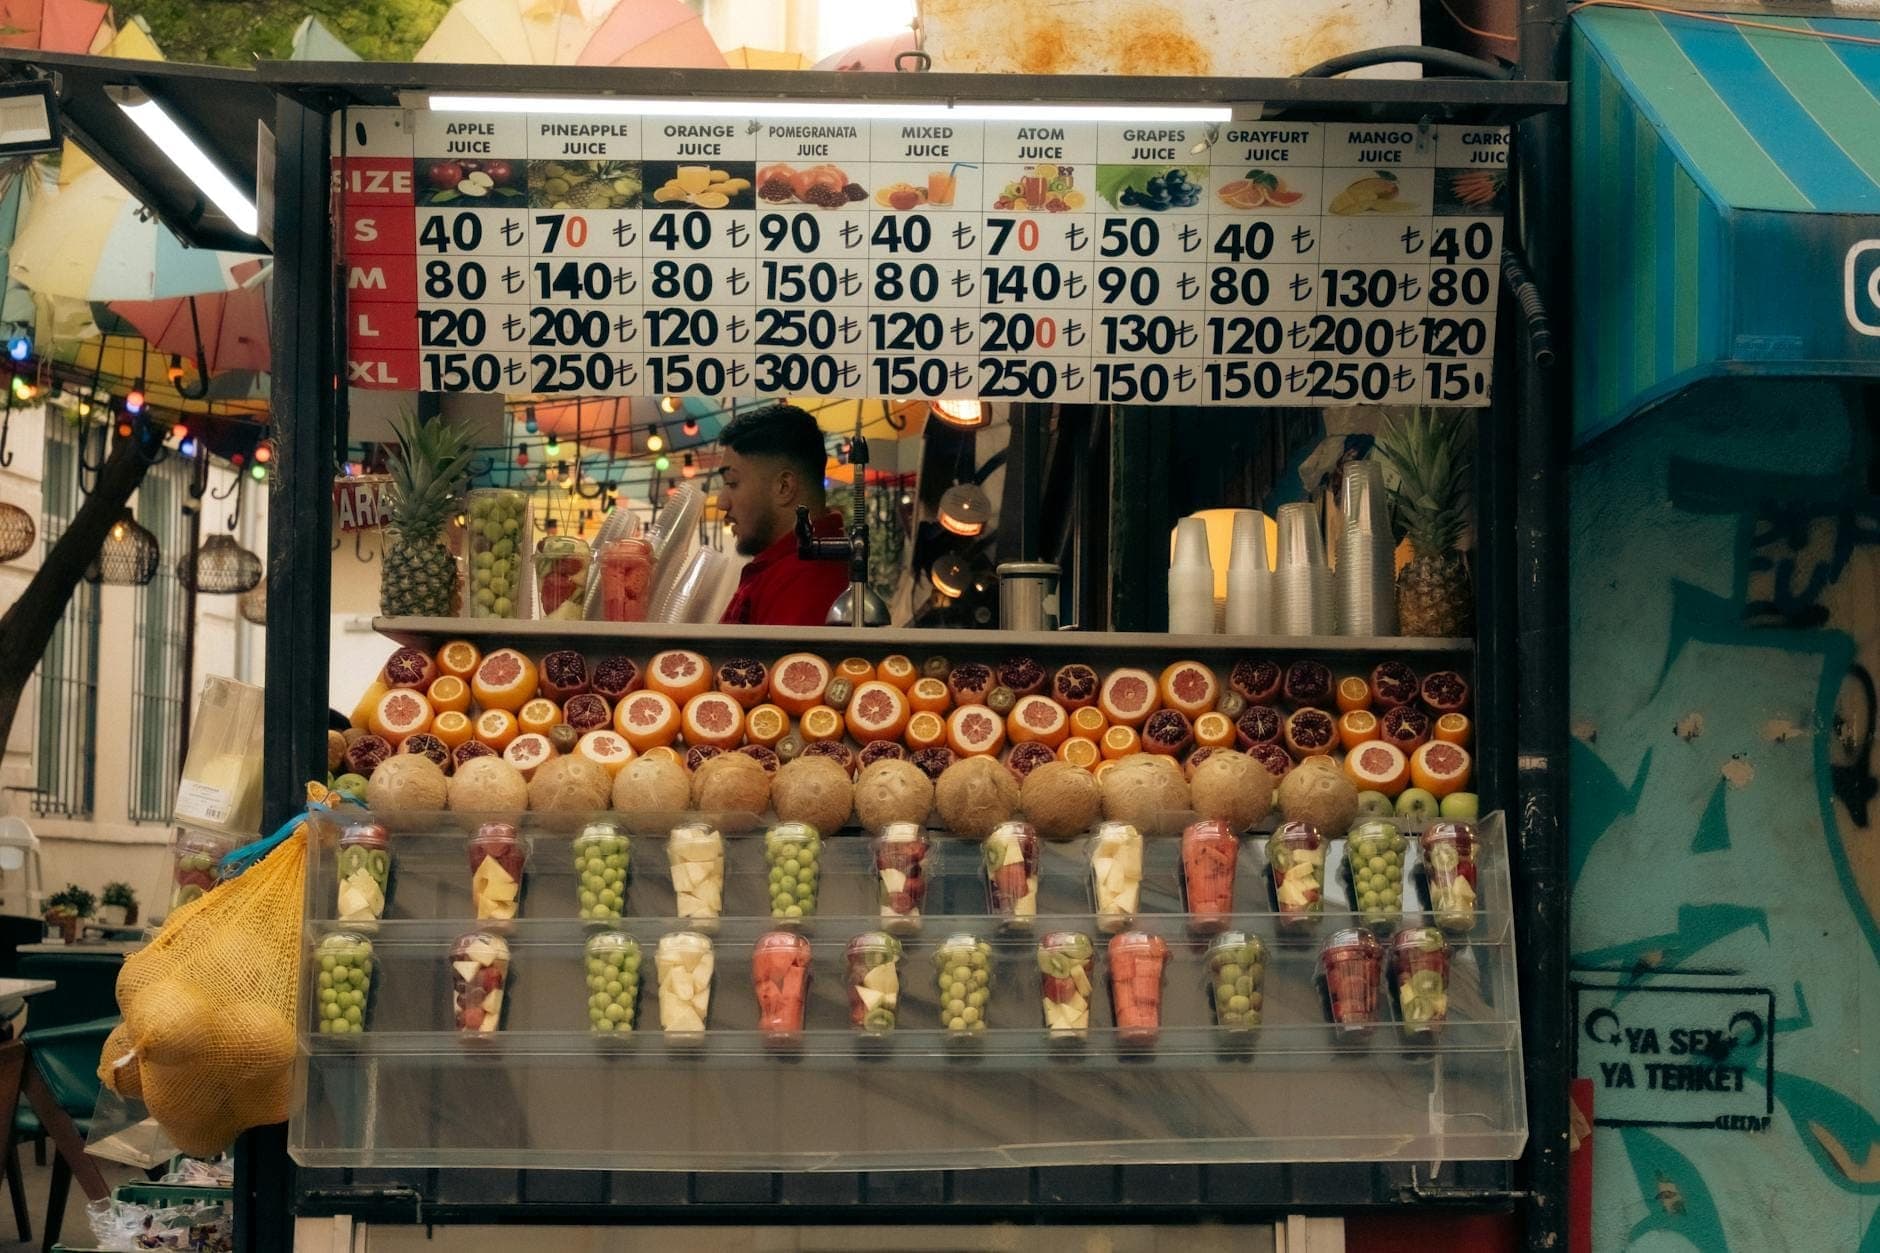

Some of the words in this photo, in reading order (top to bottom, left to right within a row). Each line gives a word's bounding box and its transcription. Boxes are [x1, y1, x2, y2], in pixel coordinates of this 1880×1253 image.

[446, 123, 495, 135] APPLE
[447, 141, 490, 153] JUICE
[541, 124, 627, 136] PINEAPPLE
[562, 142, 606, 154] JUICE
[664, 125, 734, 137] ORANGE
[769, 126, 857, 138] POMEGRANATA
[902, 127, 953, 139] MIXED
[1017, 128, 1064, 140] ATOM
[1123, 130, 1185, 142] GRAPES
[1227, 131, 1309, 143] GRAYFURT
[1348, 132, 1413, 144] MANGO
[677, 144, 721, 155] JUICE
[797, 145, 828, 156] JUICE
[905, 145, 949, 157] JUICE
[1018, 147, 1062, 159] JUICE
[1131, 148, 1175, 160] JUICE
[1245, 149, 1289, 161] JUICE
[1358, 150, 1402, 162] JUICE
[1470, 151, 1509, 163] JUIC
[354, 219, 378, 242] S
[420, 212, 482, 253] 40
[535, 214, 587, 253] 70
[649, 211, 711, 251] 40
[759, 212, 820, 253] 90
[871, 214, 931, 253] 40
[986, 218, 1039, 255] 70
[1100, 218, 1159, 257] 50
[1214, 221, 1274, 262] 40
[1430, 222, 1493, 265] 40
[349, 268, 387, 289] M
[425, 261, 486, 300] 80
[534, 262, 612, 300] 140
[652, 260, 713, 301] 80
[762, 261, 837, 302] 150
[874, 262, 939, 302] 80
[982, 263, 1060, 304] 140
[1098, 266, 1159, 306] 90
[1210, 267, 1269, 306] 80
[1321, 269, 1397, 308] 130
[1428, 268, 1489, 306] 80
[359, 315, 379, 336] L
[416, 308, 486, 347] 120
[528, 307, 610, 347] 200
[643, 308, 718, 347] 120
[754, 308, 836, 349] 250
[868, 313, 943, 351] 120
[980, 313, 1056, 353] 200
[1100, 315, 1176, 354] 130
[1207, 316, 1283, 354] 120
[1308, 315, 1394, 357] 200
[1419, 318, 1486, 357] 120
[349, 361, 398, 383] XL
[423, 353, 500, 391] 150
[531, 352, 614, 393] 250
[646, 354, 725, 395] 150
[754, 353, 837, 395] 300
[873, 356, 948, 396] 150
[978, 358, 1057, 399] 250
[1093, 363, 1169, 401] 150
[1204, 361, 1281, 401] 150
[1306, 362, 1390, 400] 250
[1625, 1028, 1660, 1054] YA
[1600, 1063, 1635, 1088] YA
